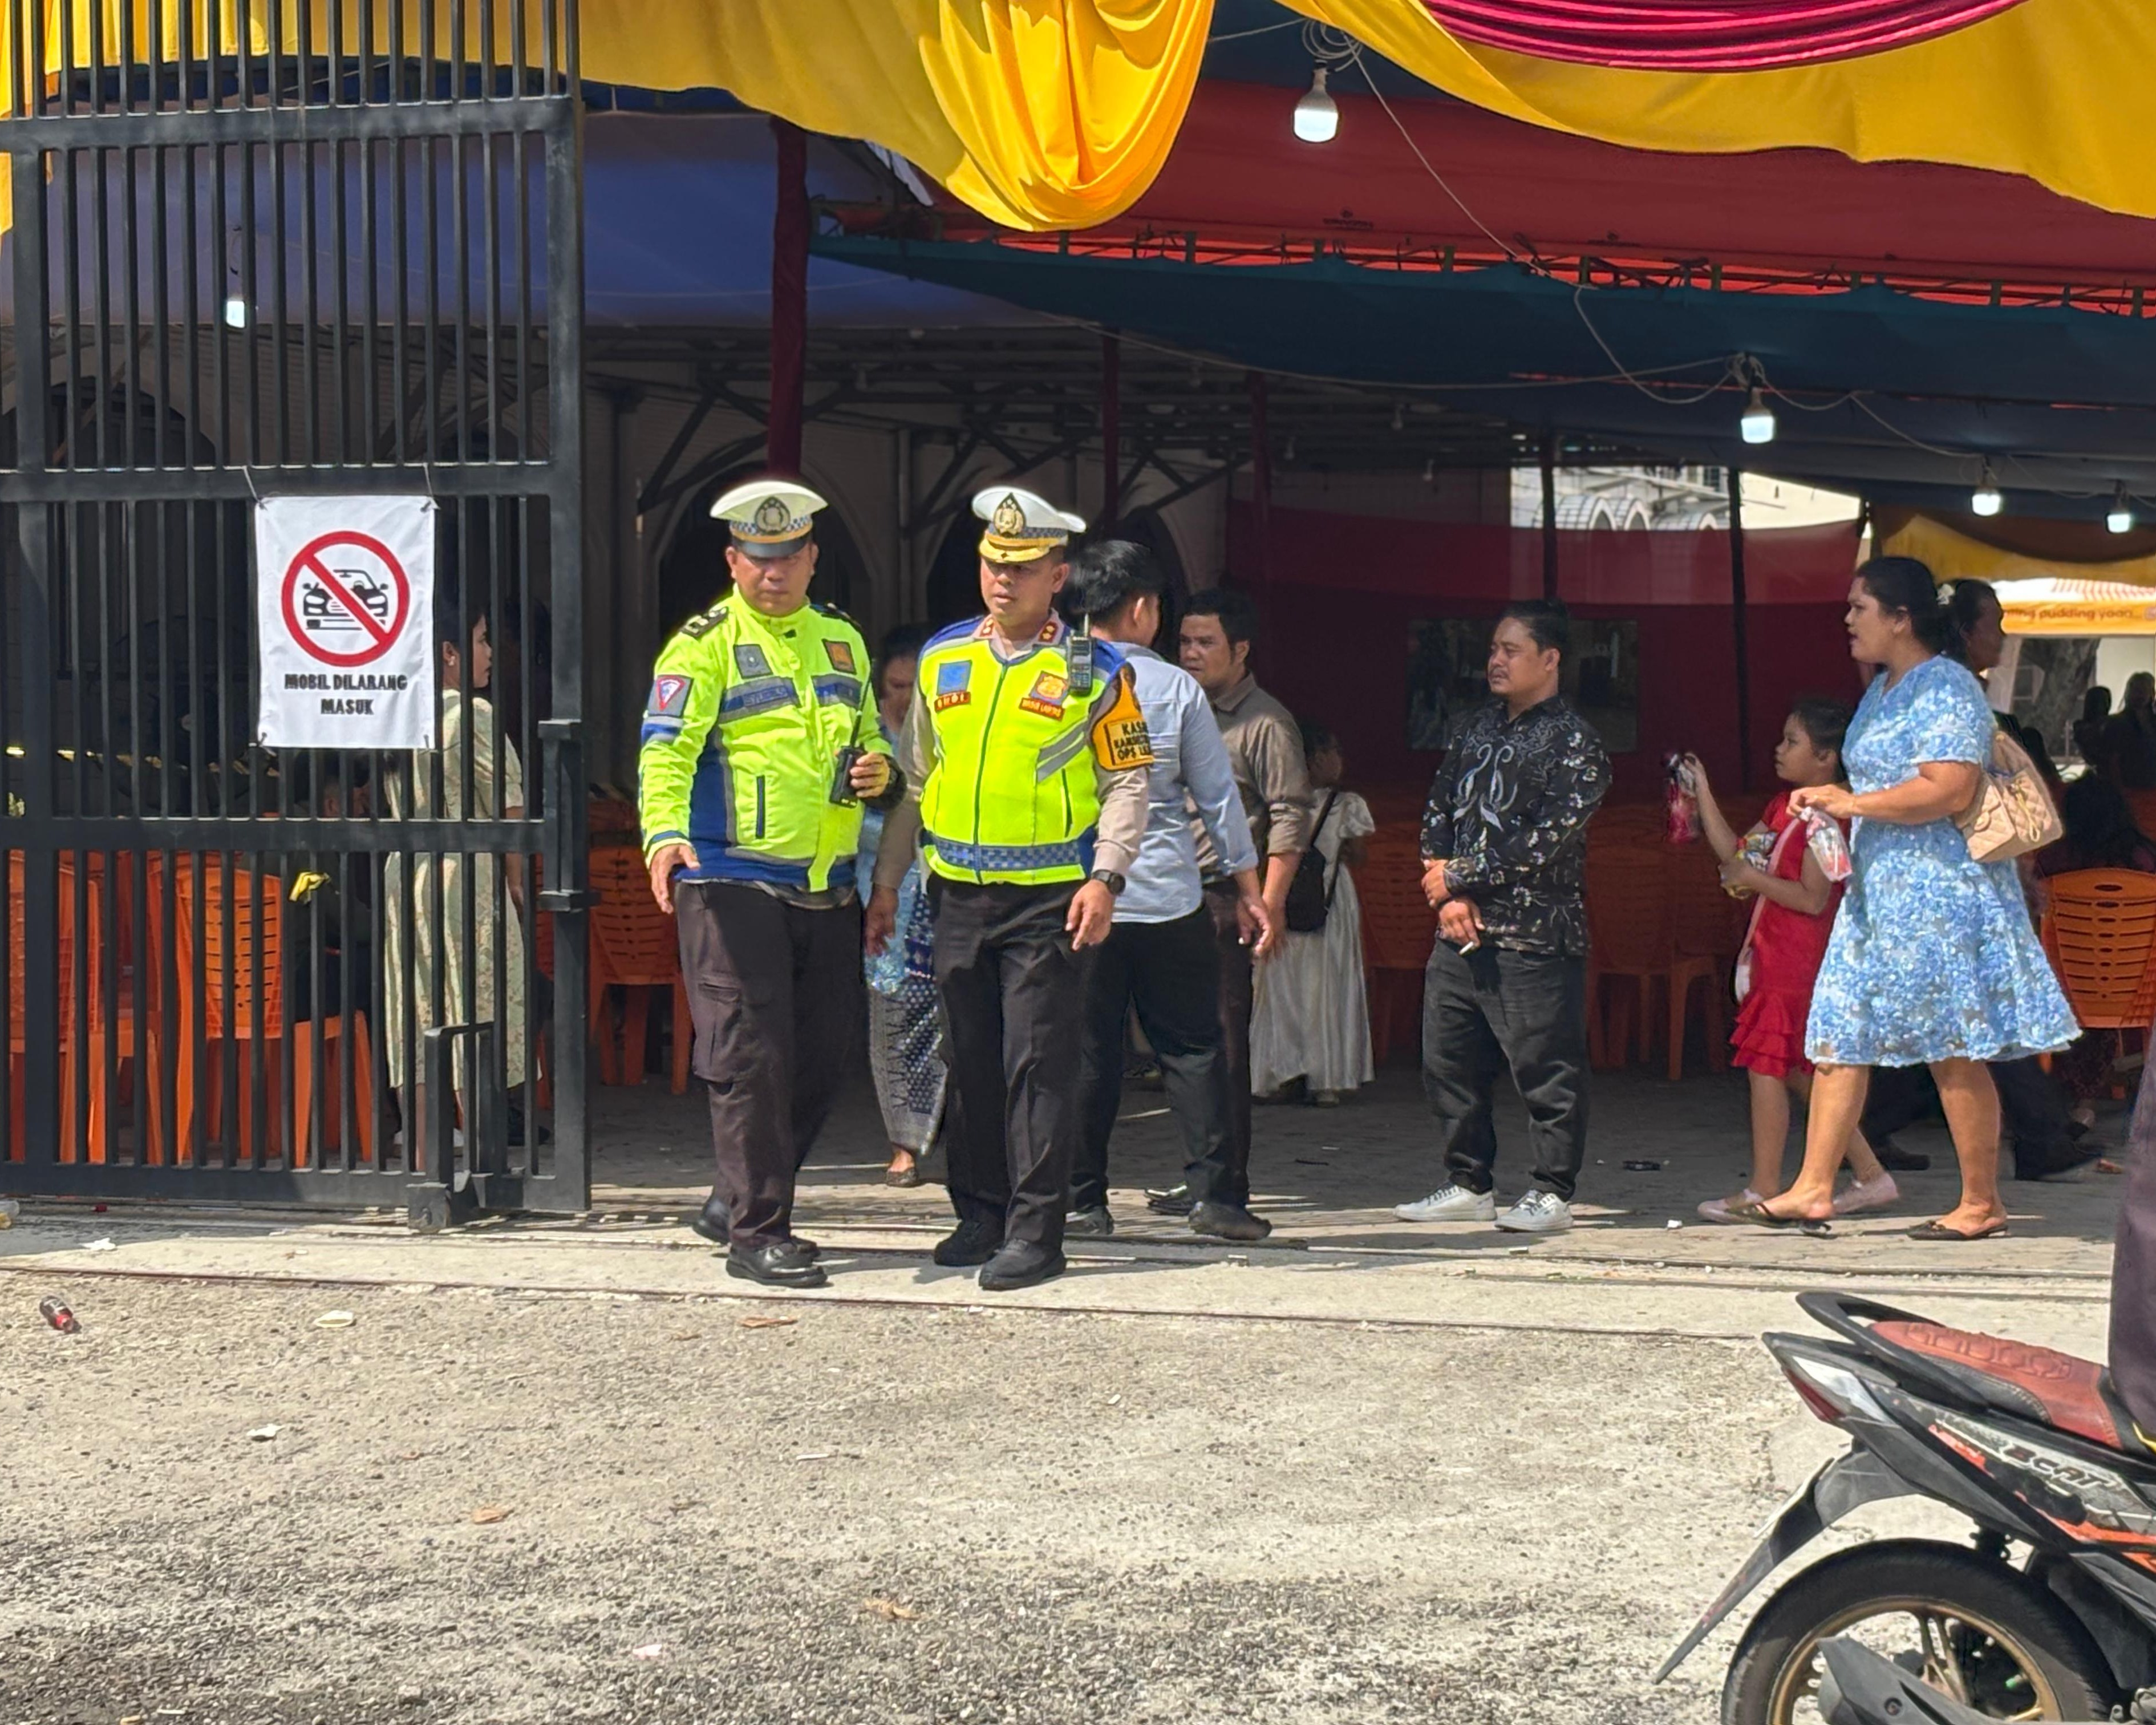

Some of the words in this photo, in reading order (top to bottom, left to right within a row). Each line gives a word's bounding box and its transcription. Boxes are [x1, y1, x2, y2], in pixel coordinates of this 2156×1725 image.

[2039, 606, 2095, 622] pudding
[285, 674, 331, 690] MOBIL
[333, 674, 408, 690] DILARANG
[321, 698, 374, 715] MASUK
